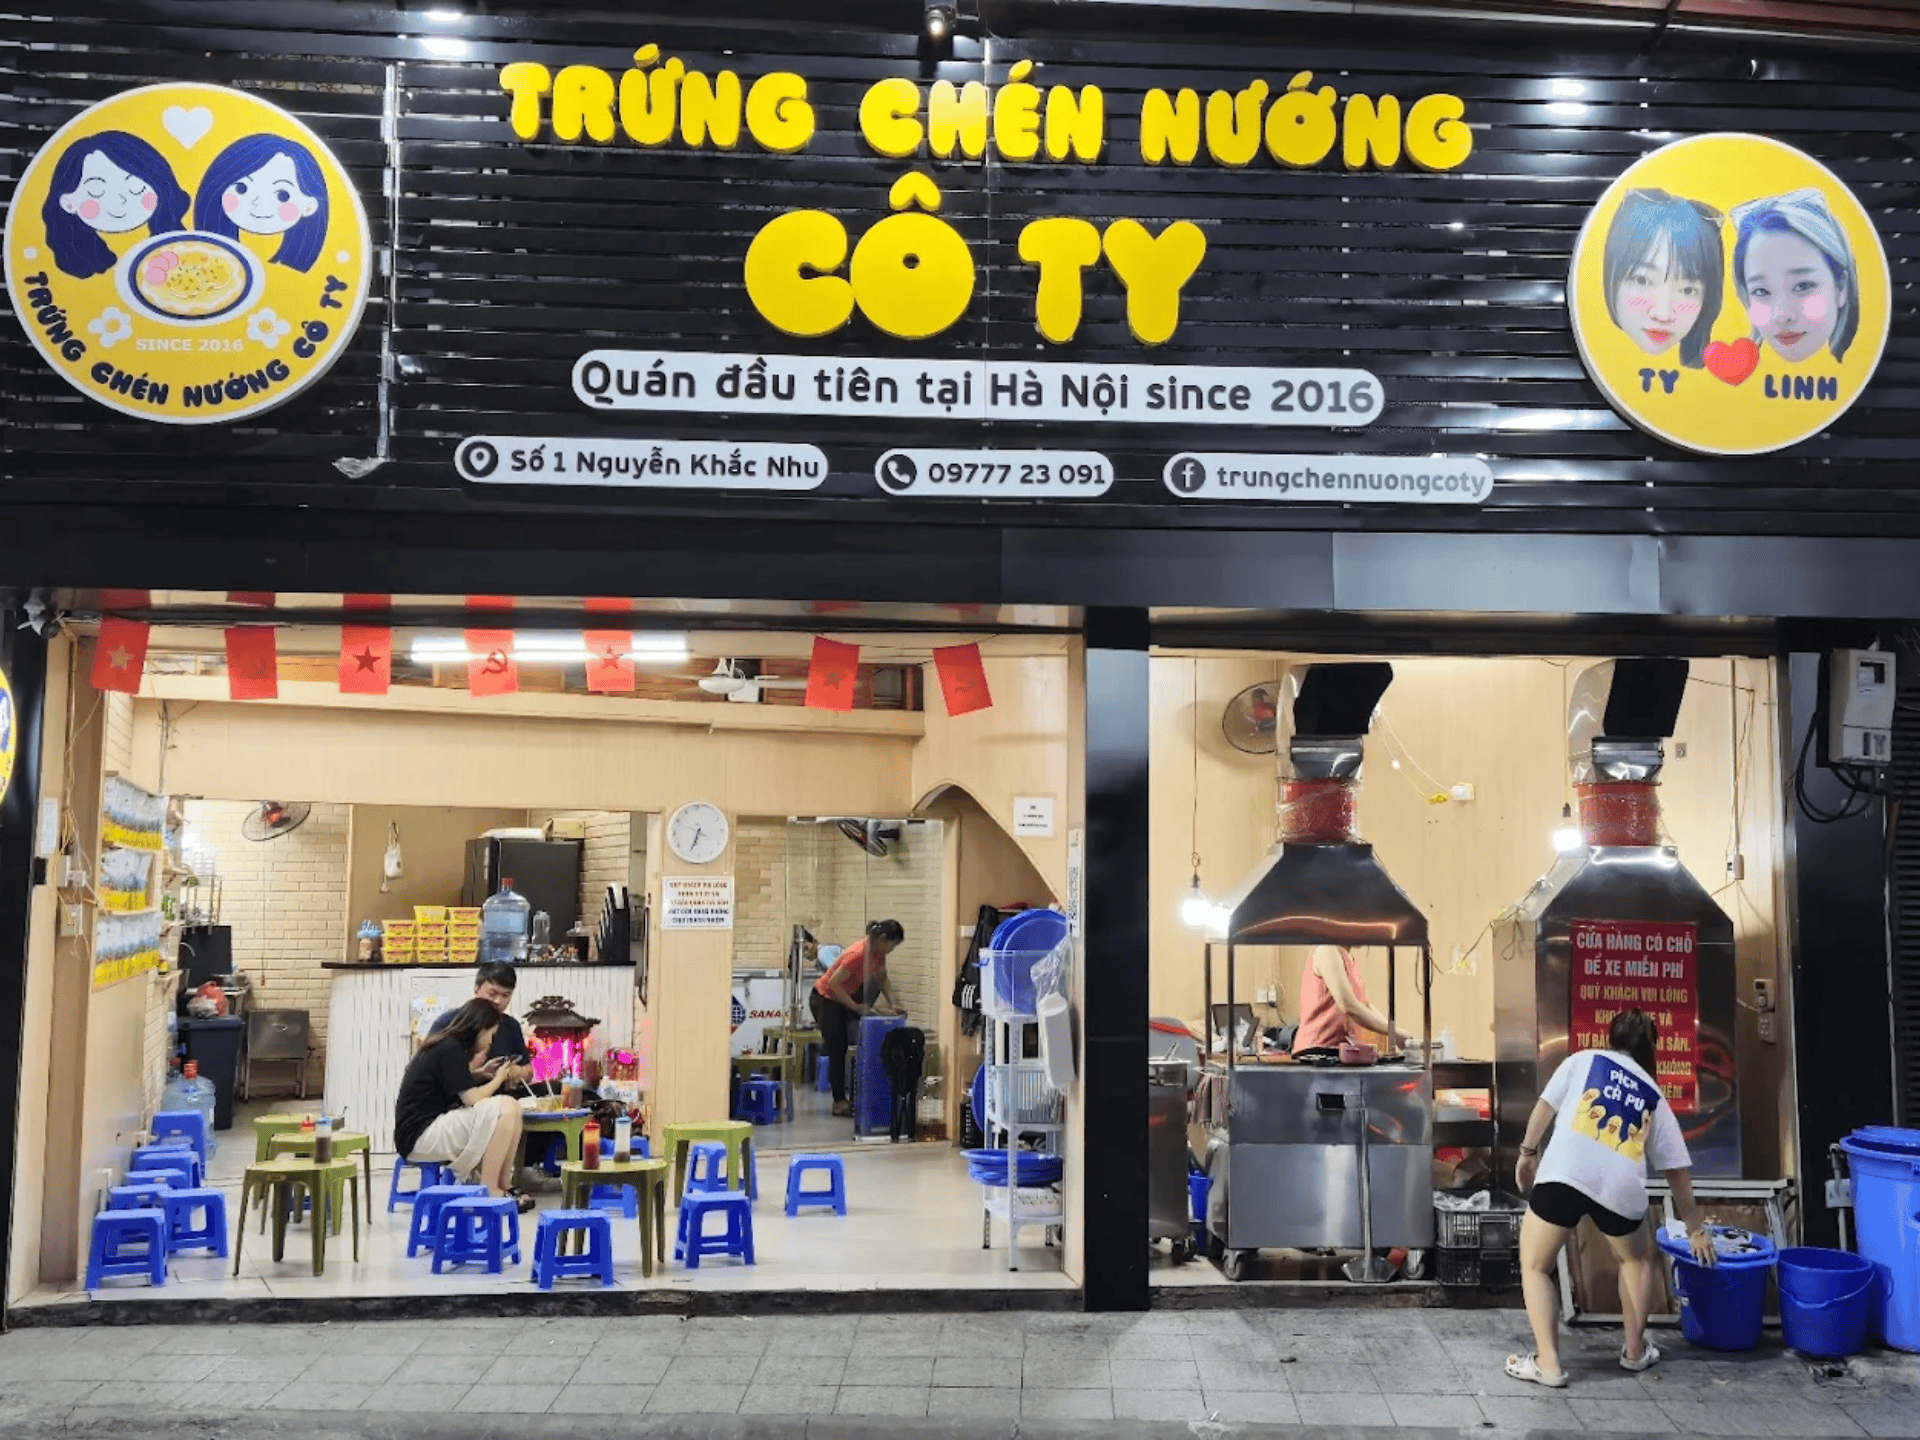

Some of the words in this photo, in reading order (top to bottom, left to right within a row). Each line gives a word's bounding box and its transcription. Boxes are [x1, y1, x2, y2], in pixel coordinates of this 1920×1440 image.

[499, 43, 815, 154] TRỨNG
[859, 60, 1103, 164] CHÉN
[1140, 71, 1473, 171] NƯỚNG
[744, 171, 975, 339] CÔ
[1018, 216, 1207, 345] TY
[24, 271, 86, 361] TRỨNG
[90, 362, 169, 405] CHÉN
[182, 359, 290, 407] NƯỚNG
[293, 320, 329, 358] CÔ
[320, 275, 348, 309] TY
[135, 338, 193, 351] SINCE
[199, 338, 245, 351] 2016
[581, 358, 696, 404] Quán
[716, 356, 795, 402] đầu
[814, 367, 898, 403] tiên
[916, 371, 972, 413] tại
[990, 369, 1044, 407] Hà
[1061, 373, 1130, 415] Nội
[1146, 375, 1251, 411] since
[1271, 380, 1375, 414] 2016
[1638, 368, 1680, 394] TY
[1764, 374, 1838, 401] LINH
[511, 444, 547, 472] Số
[553, 451, 566, 472] 1
[577, 447, 680, 479] Nguyễn
[690, 448, 757, 477] Khắc
[767, 456, 819, 478] Nhu
[928, 463, 1012, 485] 09777
[1020, 463, 1051, 486] 23
[1058, 464, 1105, 486] 091
[1216, 466, 1487, 498] trungchennuongcoty
[1576, 927, 1603, 949] CỬA
[1606, 930, 1642, 951] HÀNG
[1645, 932, 1663, 952] CÓ
[1666, 931, 1692, 953] CHỖ
[1605, 959, 1621, 976] XE
[1625, 955, 1659, 978] MIỄN
[1662, 958, 1685, 978] PHÍ
[1603, 983, 1638, 1001] KHÁCH
[1640, 986, 1657, 1003] VUI
